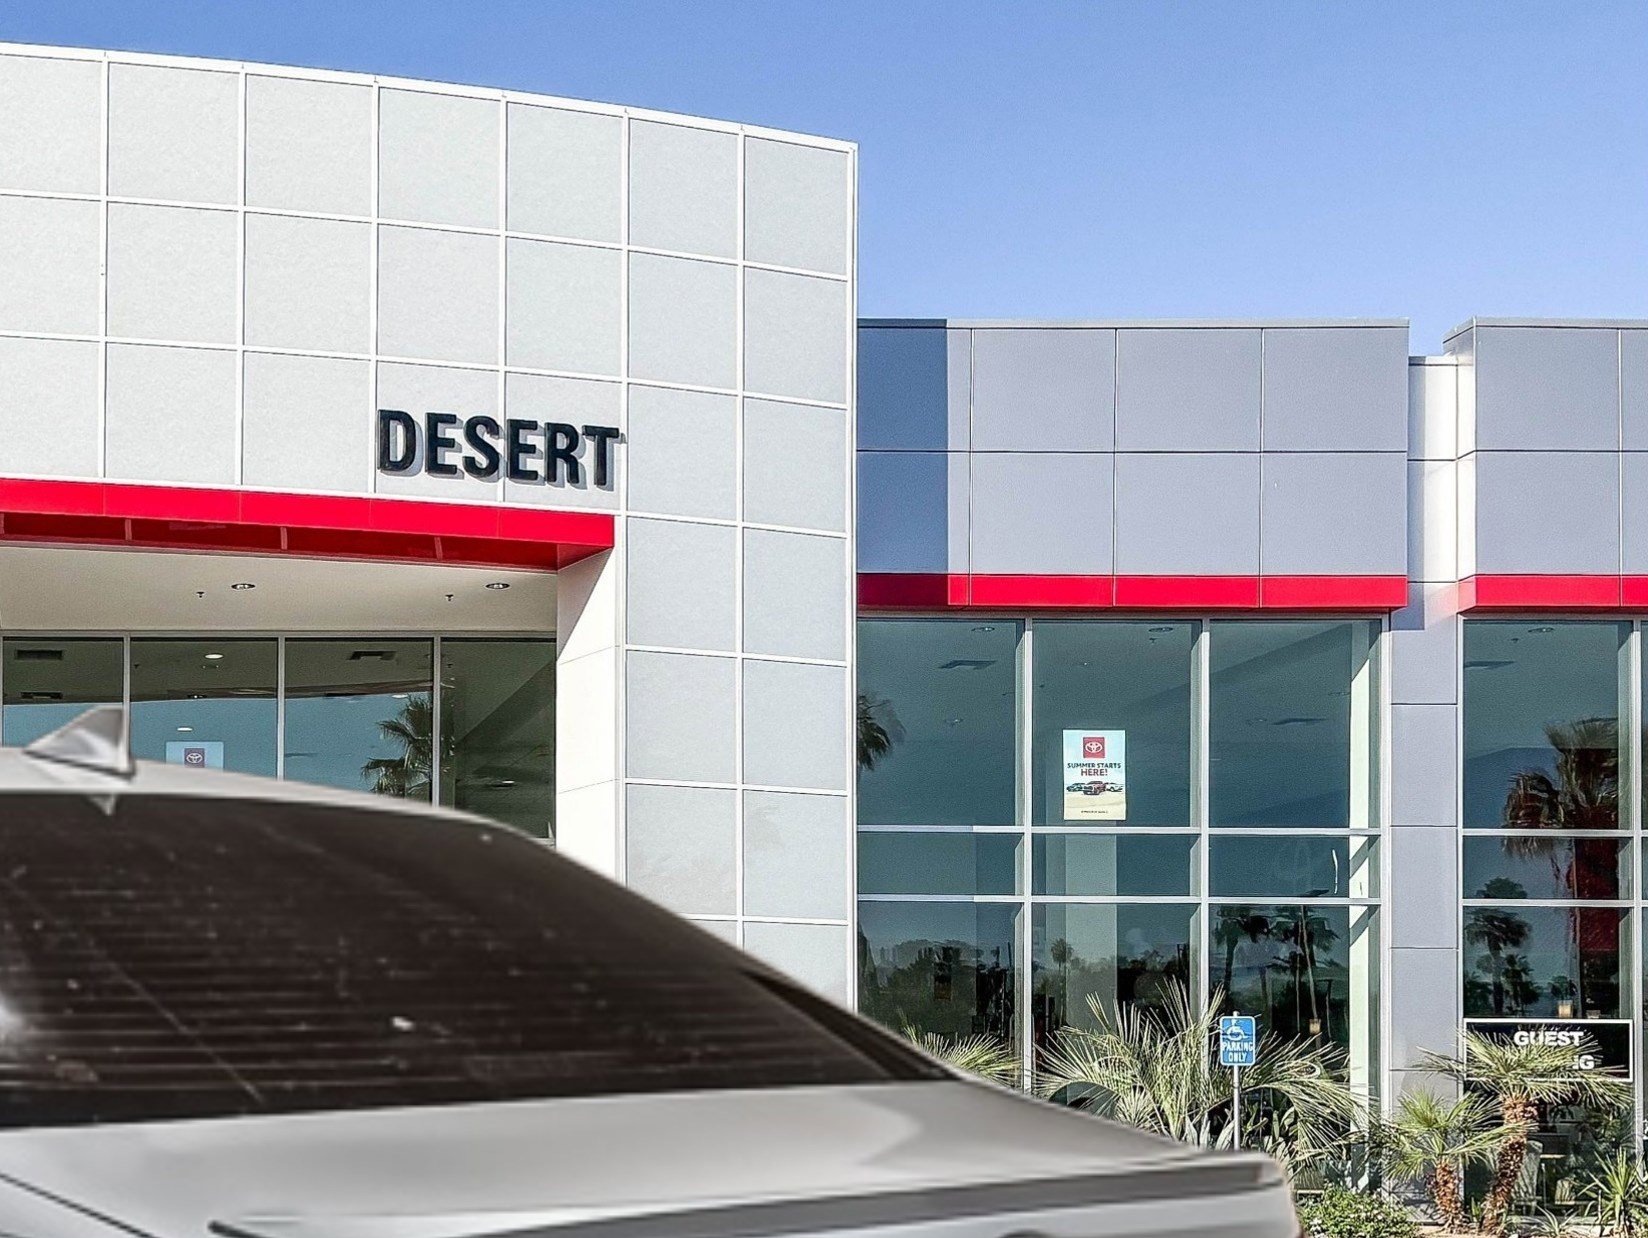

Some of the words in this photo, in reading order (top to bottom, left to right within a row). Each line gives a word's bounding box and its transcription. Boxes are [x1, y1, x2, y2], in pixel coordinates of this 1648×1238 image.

[376, 409, 620, 486] DESERT
[1513, 1031, 1583, 1046] GUEST
[1222, 1041, 1253, 1051] PARKING
[1228, 1051, 1247, 1062] ONLY
